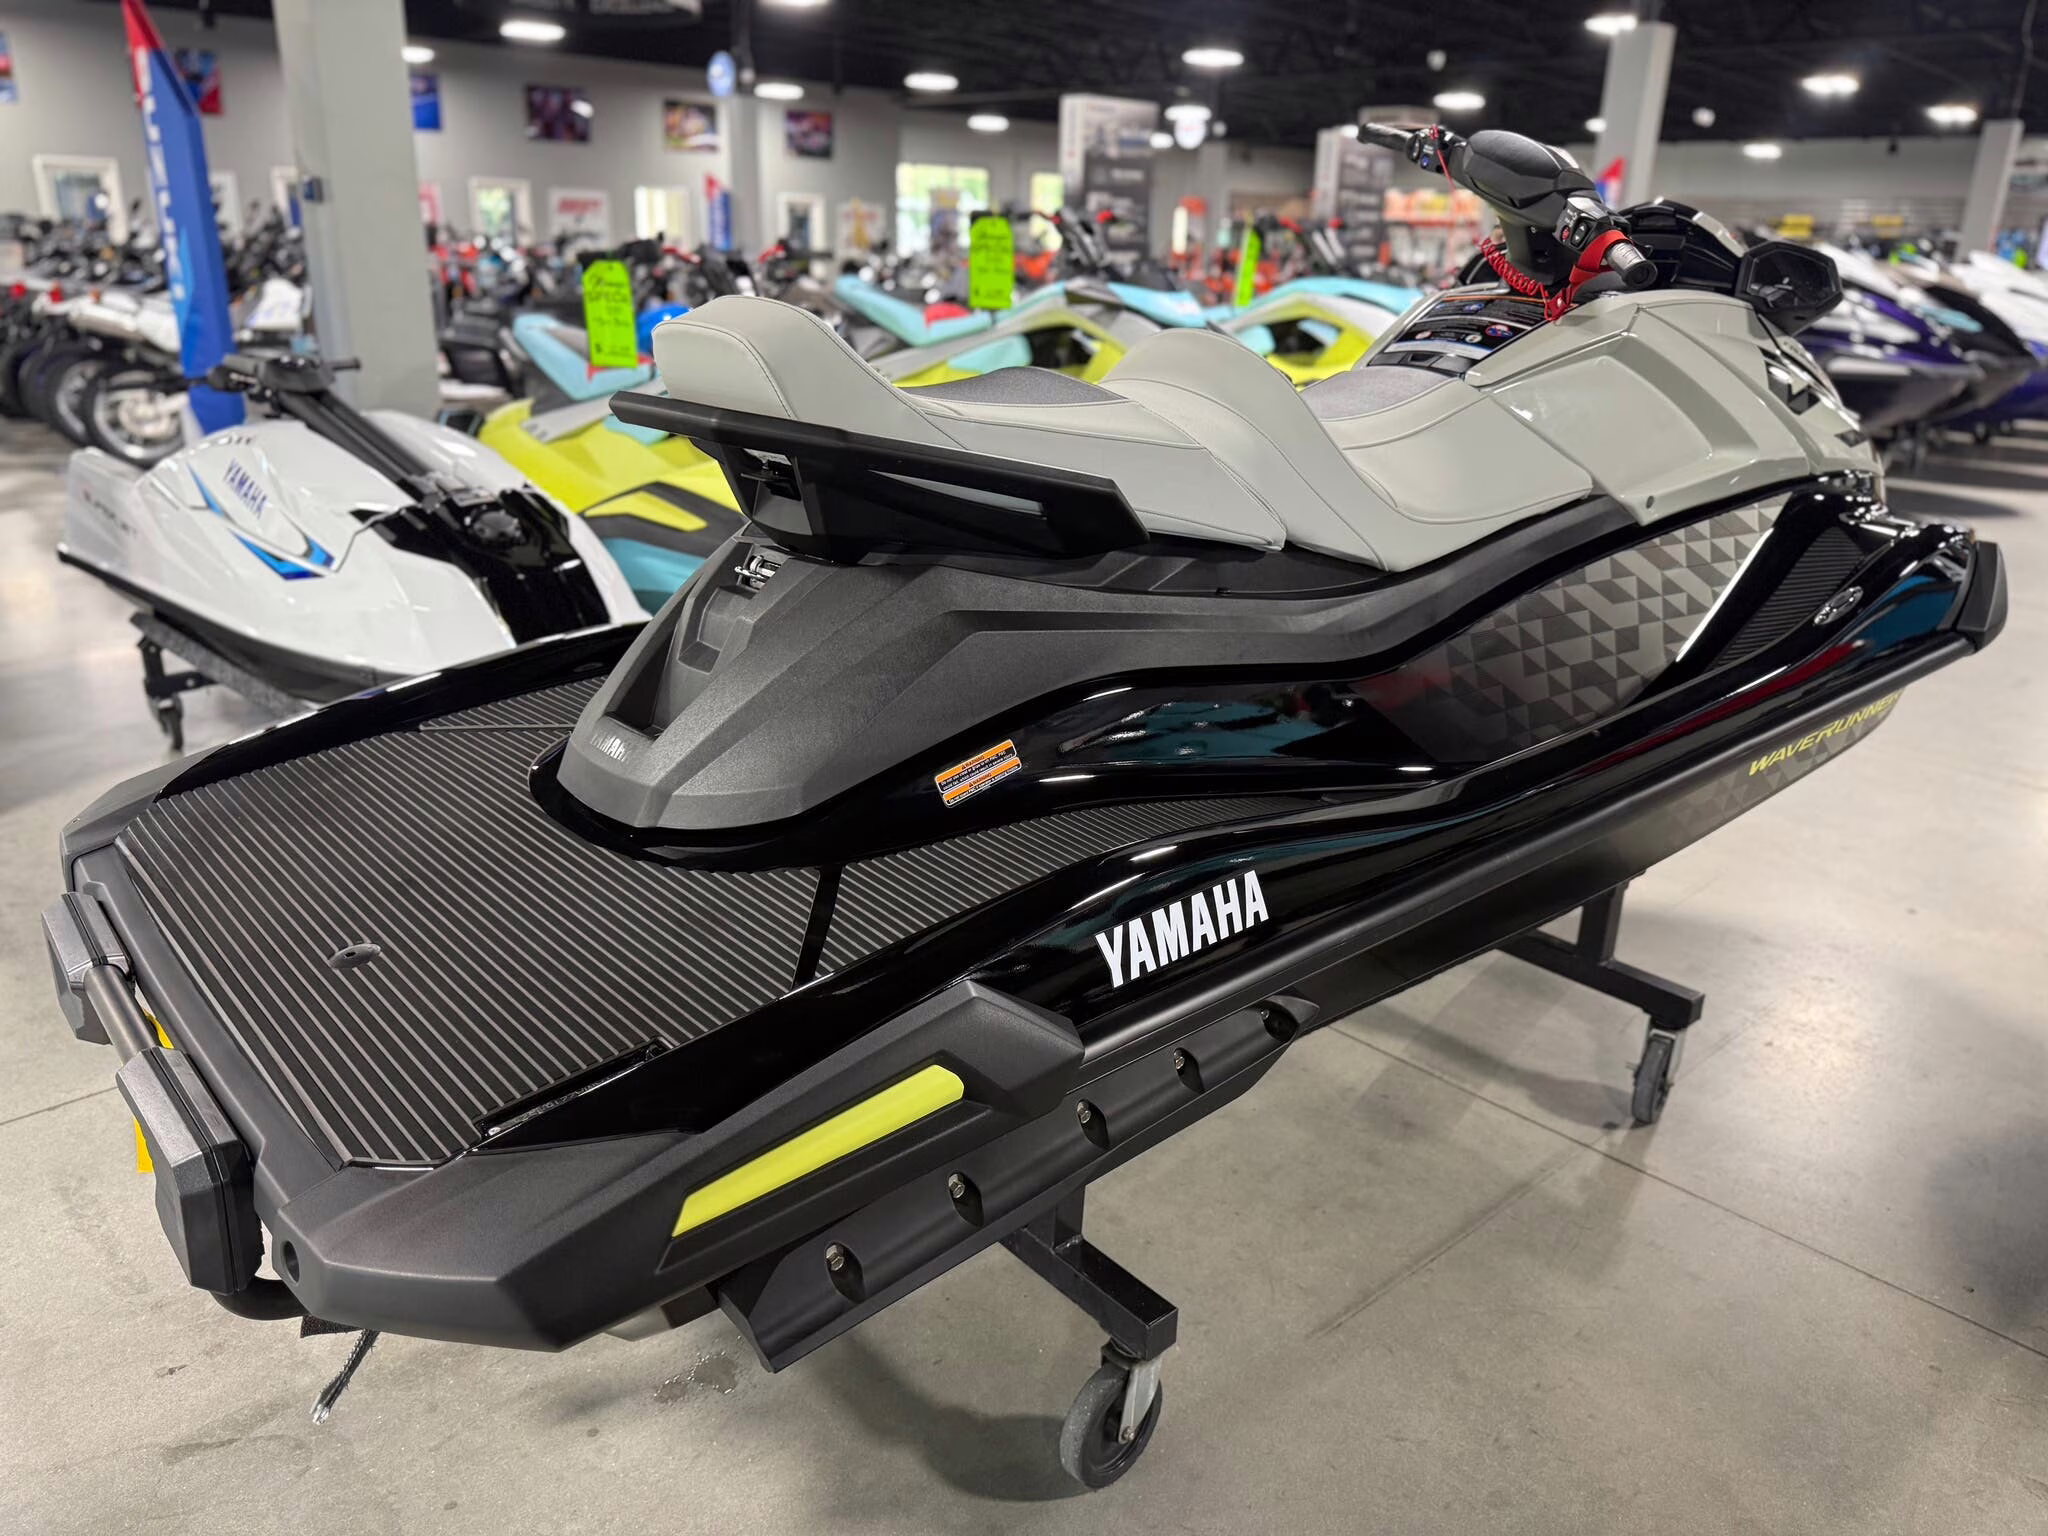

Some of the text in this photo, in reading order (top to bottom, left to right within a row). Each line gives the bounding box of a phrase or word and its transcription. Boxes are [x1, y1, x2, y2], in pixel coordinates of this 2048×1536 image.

[224, 458, 267, 519] YAMAHA
[1749, 690, 1904, 776] WAVERUNNER
[1095, 870, 1269, 988] YAMAHA
